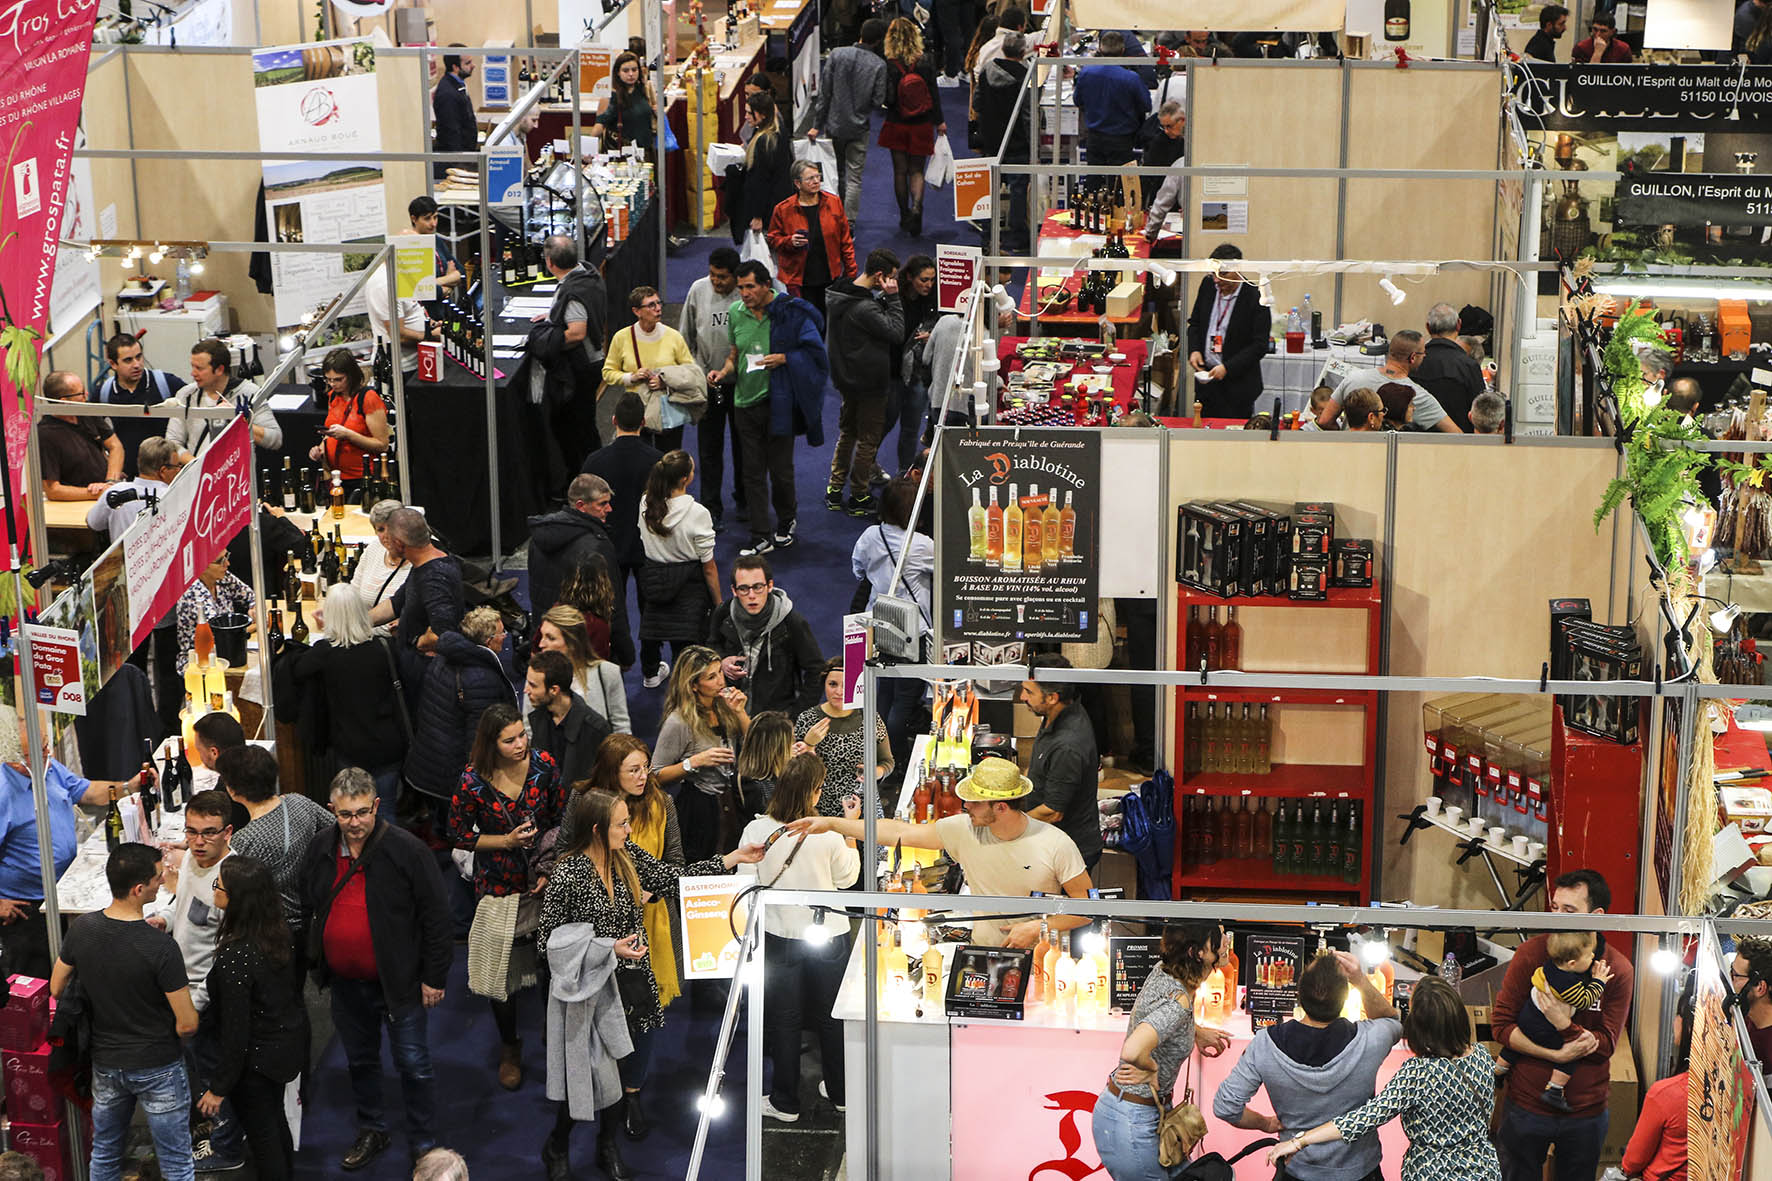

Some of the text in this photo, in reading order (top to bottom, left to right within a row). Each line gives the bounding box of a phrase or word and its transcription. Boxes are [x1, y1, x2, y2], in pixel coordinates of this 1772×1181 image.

[1578, 74, 1635, 88] GUILLON,
[1637, 75, 1676, 90] l'Esprit
[1678, 75, 1693, 87] du
[1696, 76, 1720, 87] Malt
[1723, 76, 1737, 87] de
[1754, 77, 1772, 88] Mo
[7, 94, 18, 106] DU
[20, 83, 47, 99] RHÔNE
[1680, 91, 1772, 103] 51150 LOUVOIS
[8, 111, 19, 123] DU
[22, 100, 48, 117] RHÔNE
[48, 88, 80, 106] VILLAGES
[1630, 184, 1695, 198] GUILLON,
[1698, 185, 1742, 200] l'Esprit
[1744, 186, 1759, 199] du
[32, 131, 70, 319] www.grospata.fr
[959, 439, 990, 448] Fabriqué
[1050, 441, 1085, 449] Guérande
[958, 452, 1085, 489] La Diablotine
[194, 472, 227, 546] Gros
[953, 575, 990, 583] BOISSON
[991, 575, 1047, 584] AROMATISÉE
[1022, 585, 1040, 593] (14%
[32, 643, 67, 655] Domaine
[33, 652, 64, 663] du Gros
[34, 661, 52, 670] Pata
[684, 884, 735, 892] GASTRONOM
[686, 910, 728, 919] Ginseng
[1263, 945, 1298, 959] Diablotine
